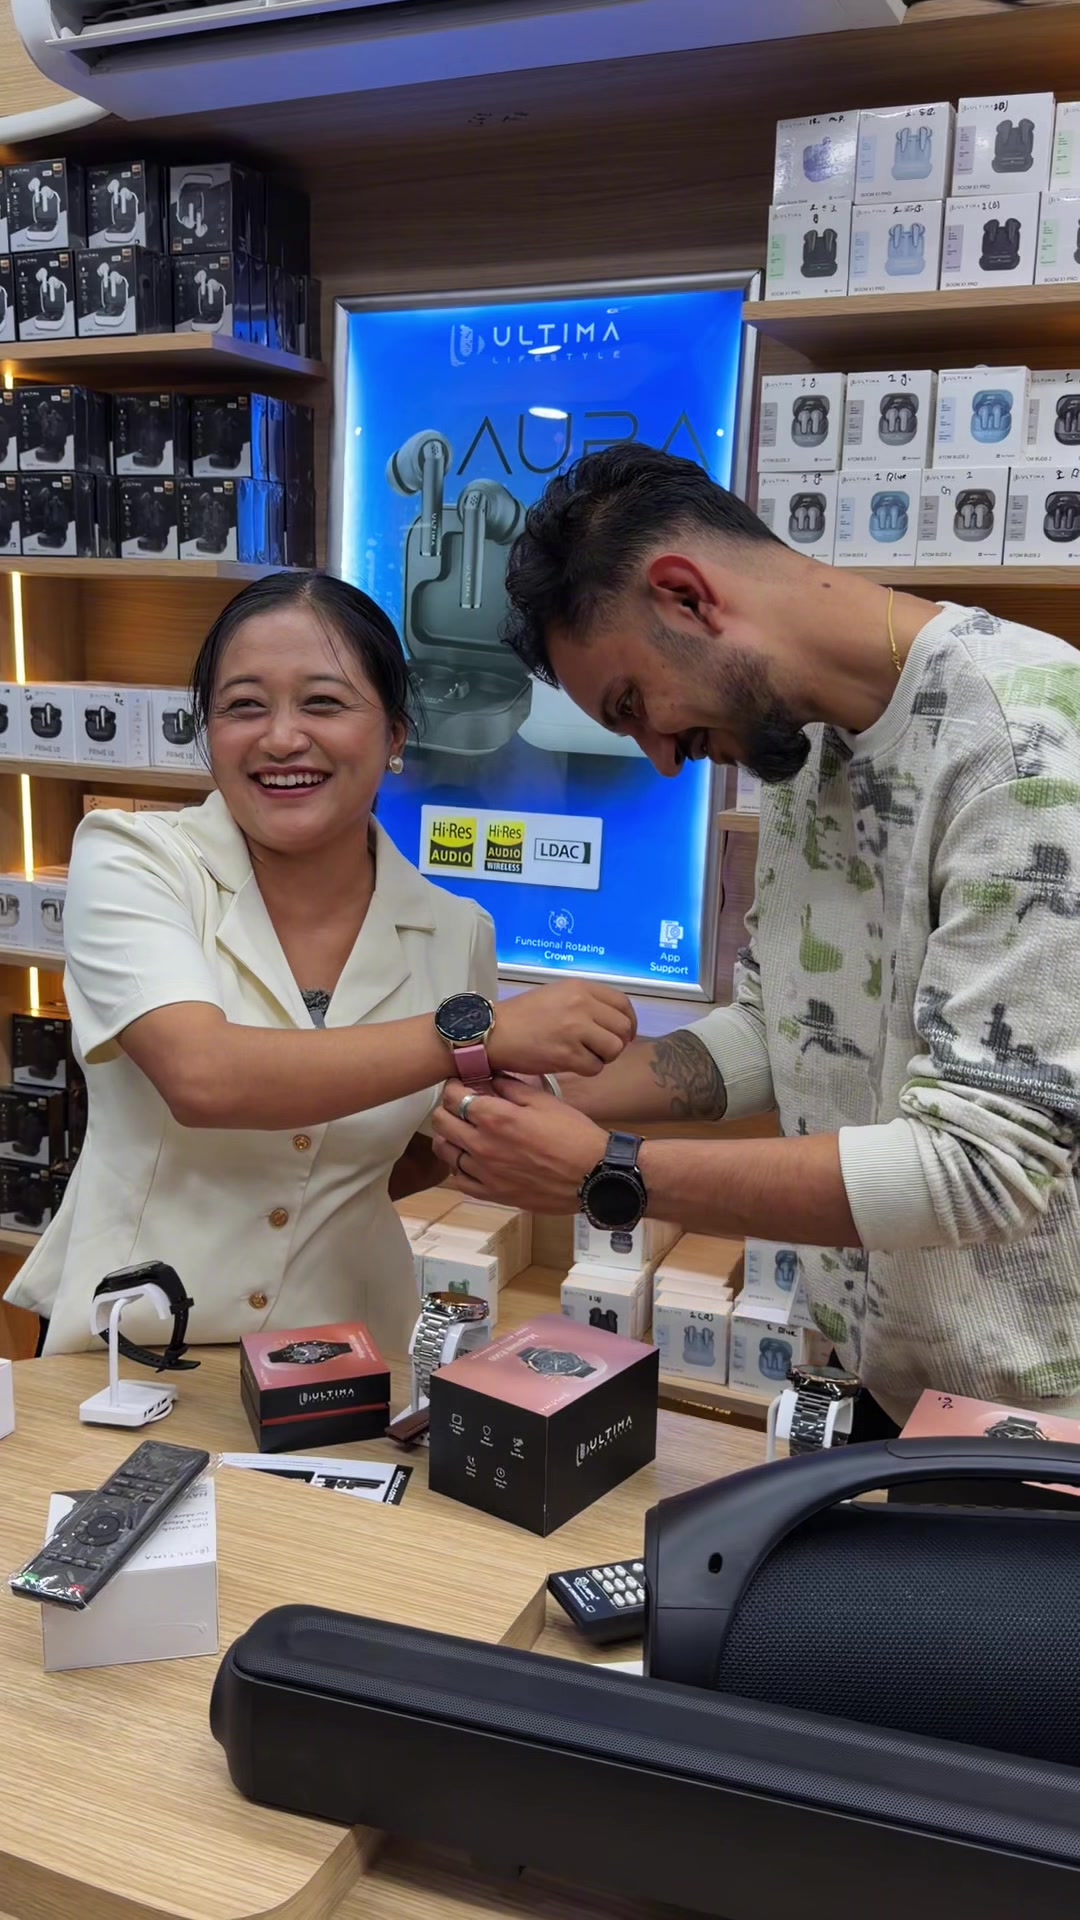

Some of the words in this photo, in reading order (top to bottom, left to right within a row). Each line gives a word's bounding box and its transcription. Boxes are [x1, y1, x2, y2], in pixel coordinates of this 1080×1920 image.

[493, 320, 620, 347] ULTIMA
[431, 849, 472, 864] AUDIO
[487, 846, 521, 861] AUDIO
[540, 842, 579, 859] LDAC
[486, 861, 520, 873] WIRELESS
[515, 936, 564, 950] Functional
[565, 941, 605, 956] Rotating
[544, 951, 574, 962] Crown
[659, 952, 680, 964] App
[650, 962, 689, 975] Support
[312, 1388, 355, 1400] ULTIMA
[590, 1415, 632, 1450] ULTIMA
